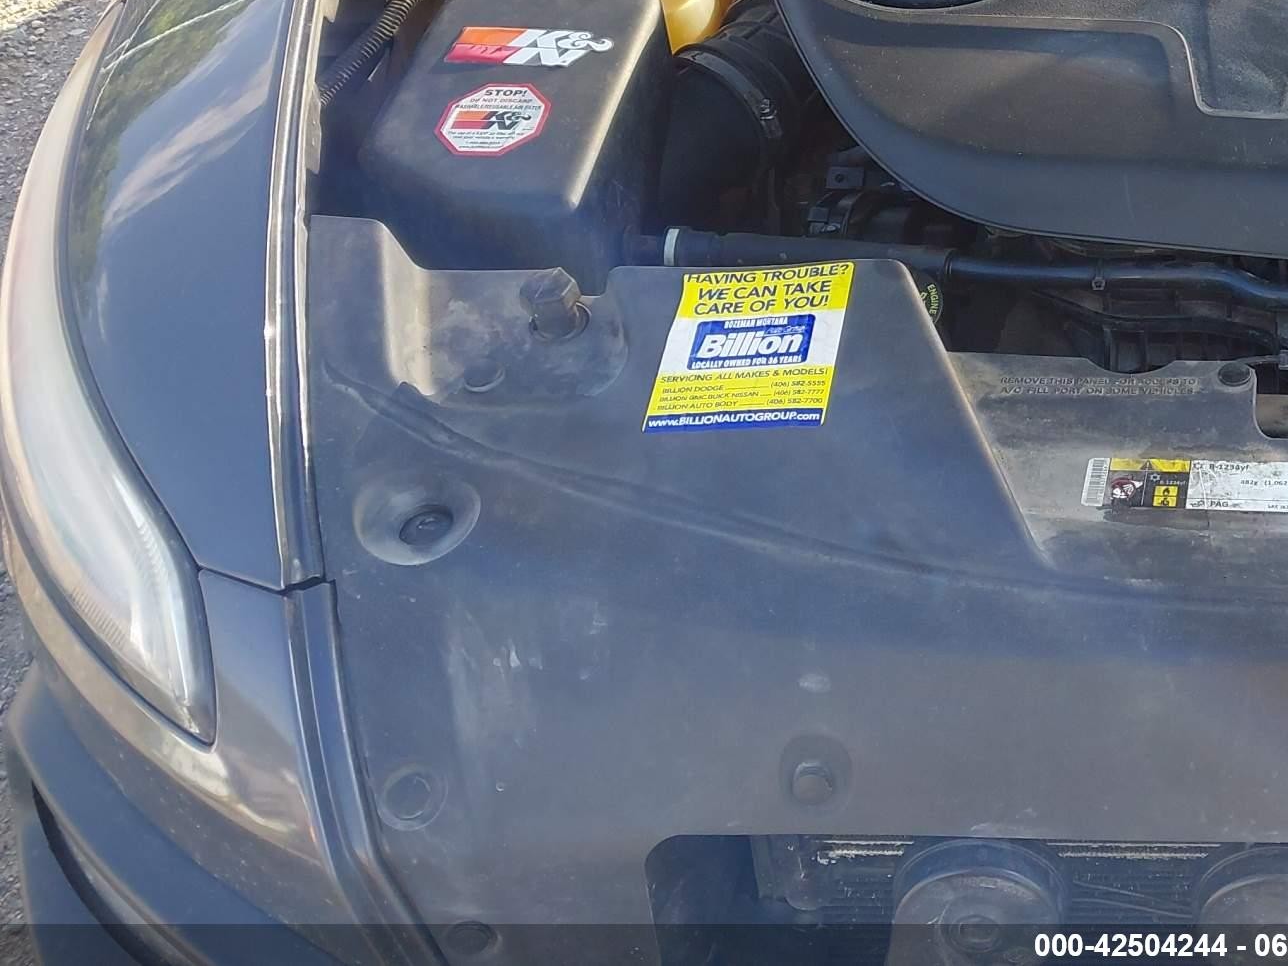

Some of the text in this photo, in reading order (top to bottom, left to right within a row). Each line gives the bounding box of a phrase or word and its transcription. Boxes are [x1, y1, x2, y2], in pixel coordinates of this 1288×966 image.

[484, 89, 528, 98] STOP!
[687, 264, 849, 284] HAVING TROUBLE?
[698, 280, 832, 300] WE CAN TAKE
[694, 295, 829, 315] CARE OF YOU!
[696, 332, 803, 358] Billion
[691, 361, 722, 369] LOCALLY
[723, 359, 751, 367] OWNED
[751, 357, 767, 365] FOR
[779, 355, 801, 363] YEARS
[661, 375, 712, 384] SERVICING
[715, 373, 733, 381] ALL
[735, 371, 770, 381] MAKES
[782, 368, 828, 376] MODELS!
[648, 412, 820, 427] www.BILLIONAUTOGROUP.com
